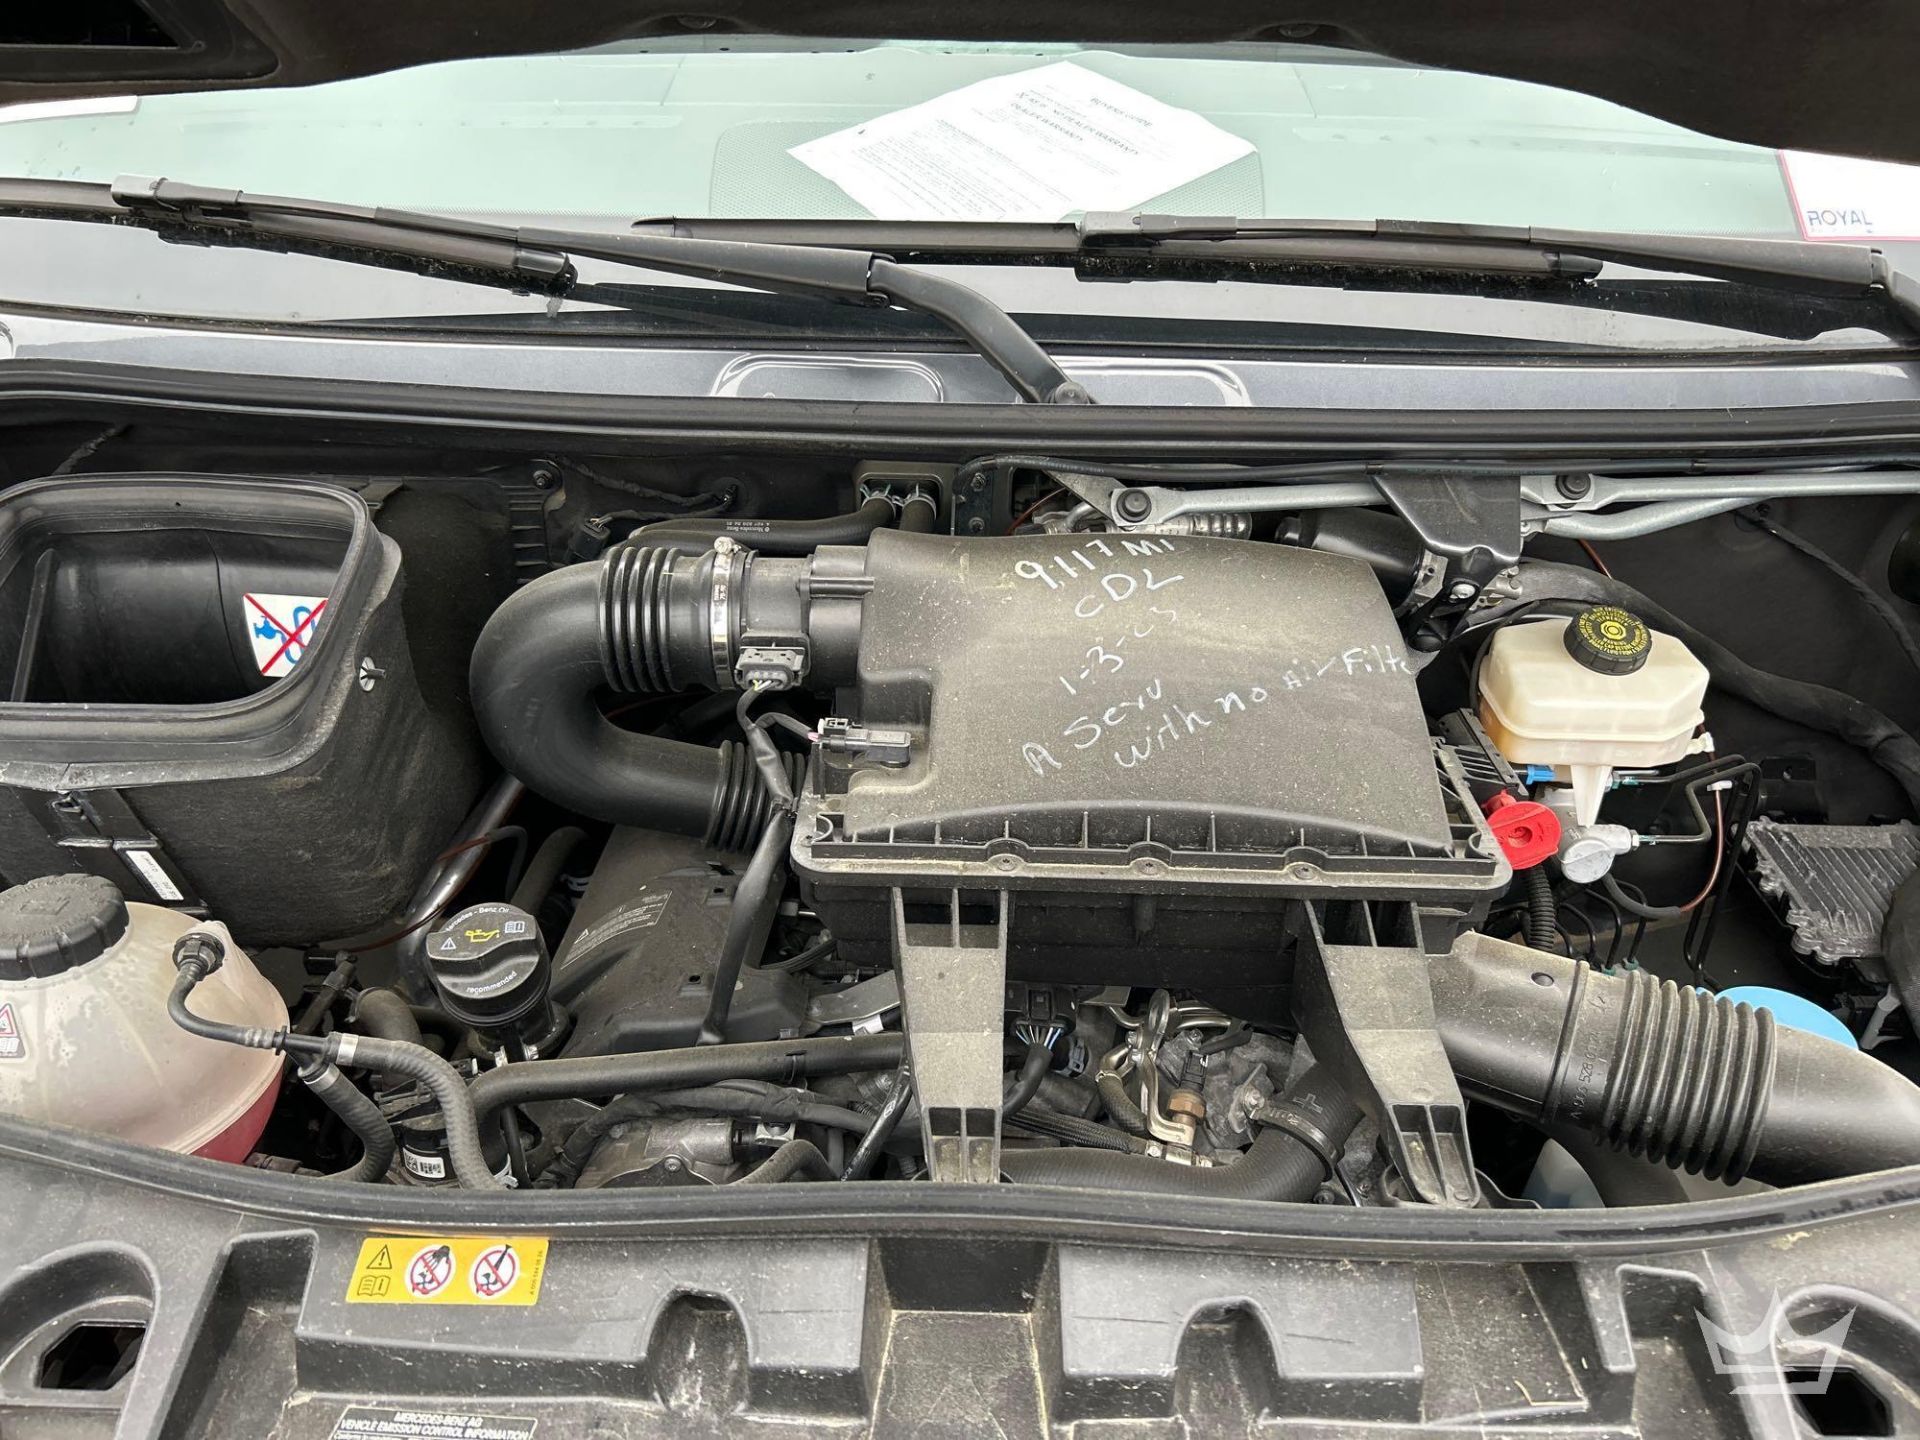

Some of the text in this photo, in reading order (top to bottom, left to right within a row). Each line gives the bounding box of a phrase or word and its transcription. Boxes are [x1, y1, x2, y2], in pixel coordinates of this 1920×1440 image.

[1807, 210, 1873, 226] ROYAL
[1074, 568, 1185, 618] CDL
[1114, 704, 1212, 768] with
[1214, 686, 1268, 714] no
[1022, 742, 1062, 776] A
[466, 970, 518, 994] recommended
[340, 1419, 530, 1440] VEHICLE EMISSION CONTROL INFORMATION
